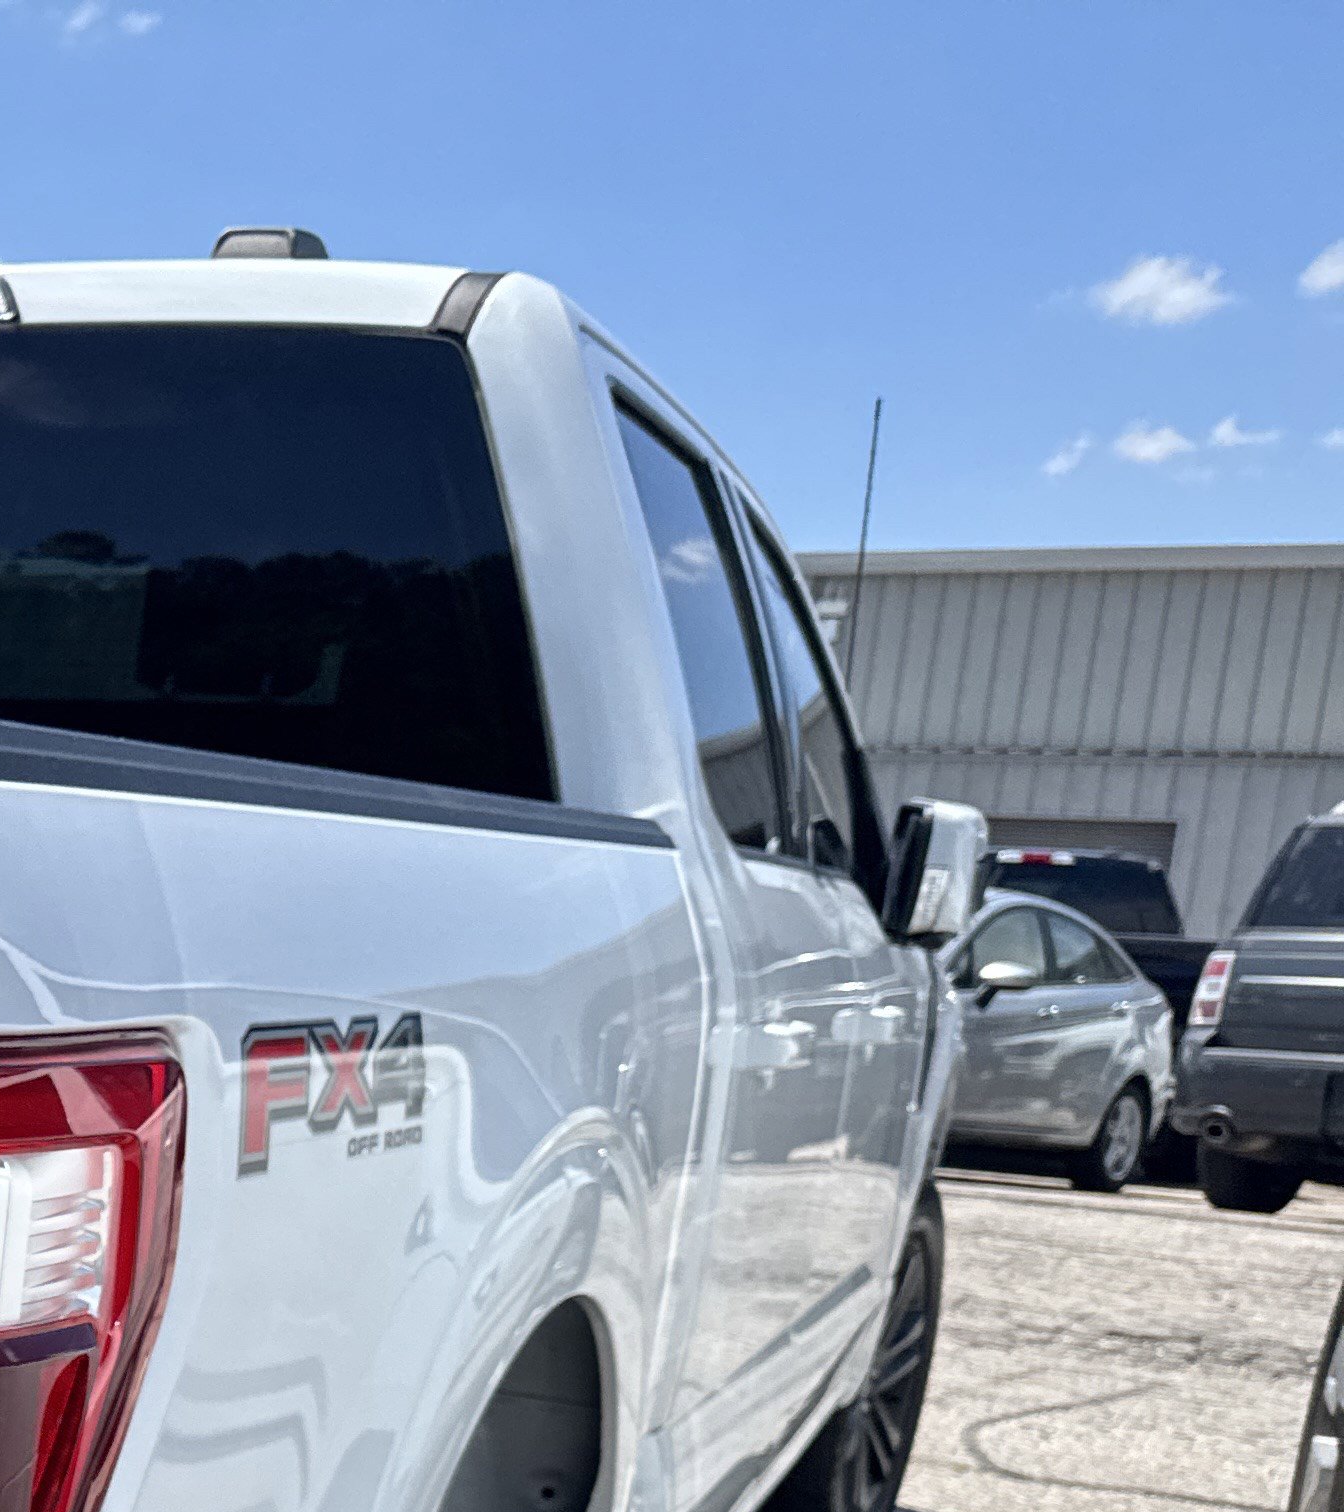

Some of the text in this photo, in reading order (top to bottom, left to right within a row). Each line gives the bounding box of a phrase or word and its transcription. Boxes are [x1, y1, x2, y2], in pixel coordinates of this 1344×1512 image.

[236, 1010, 426, 1180] FX4
[346, 1125, 423, 1158] OFF ROAD
